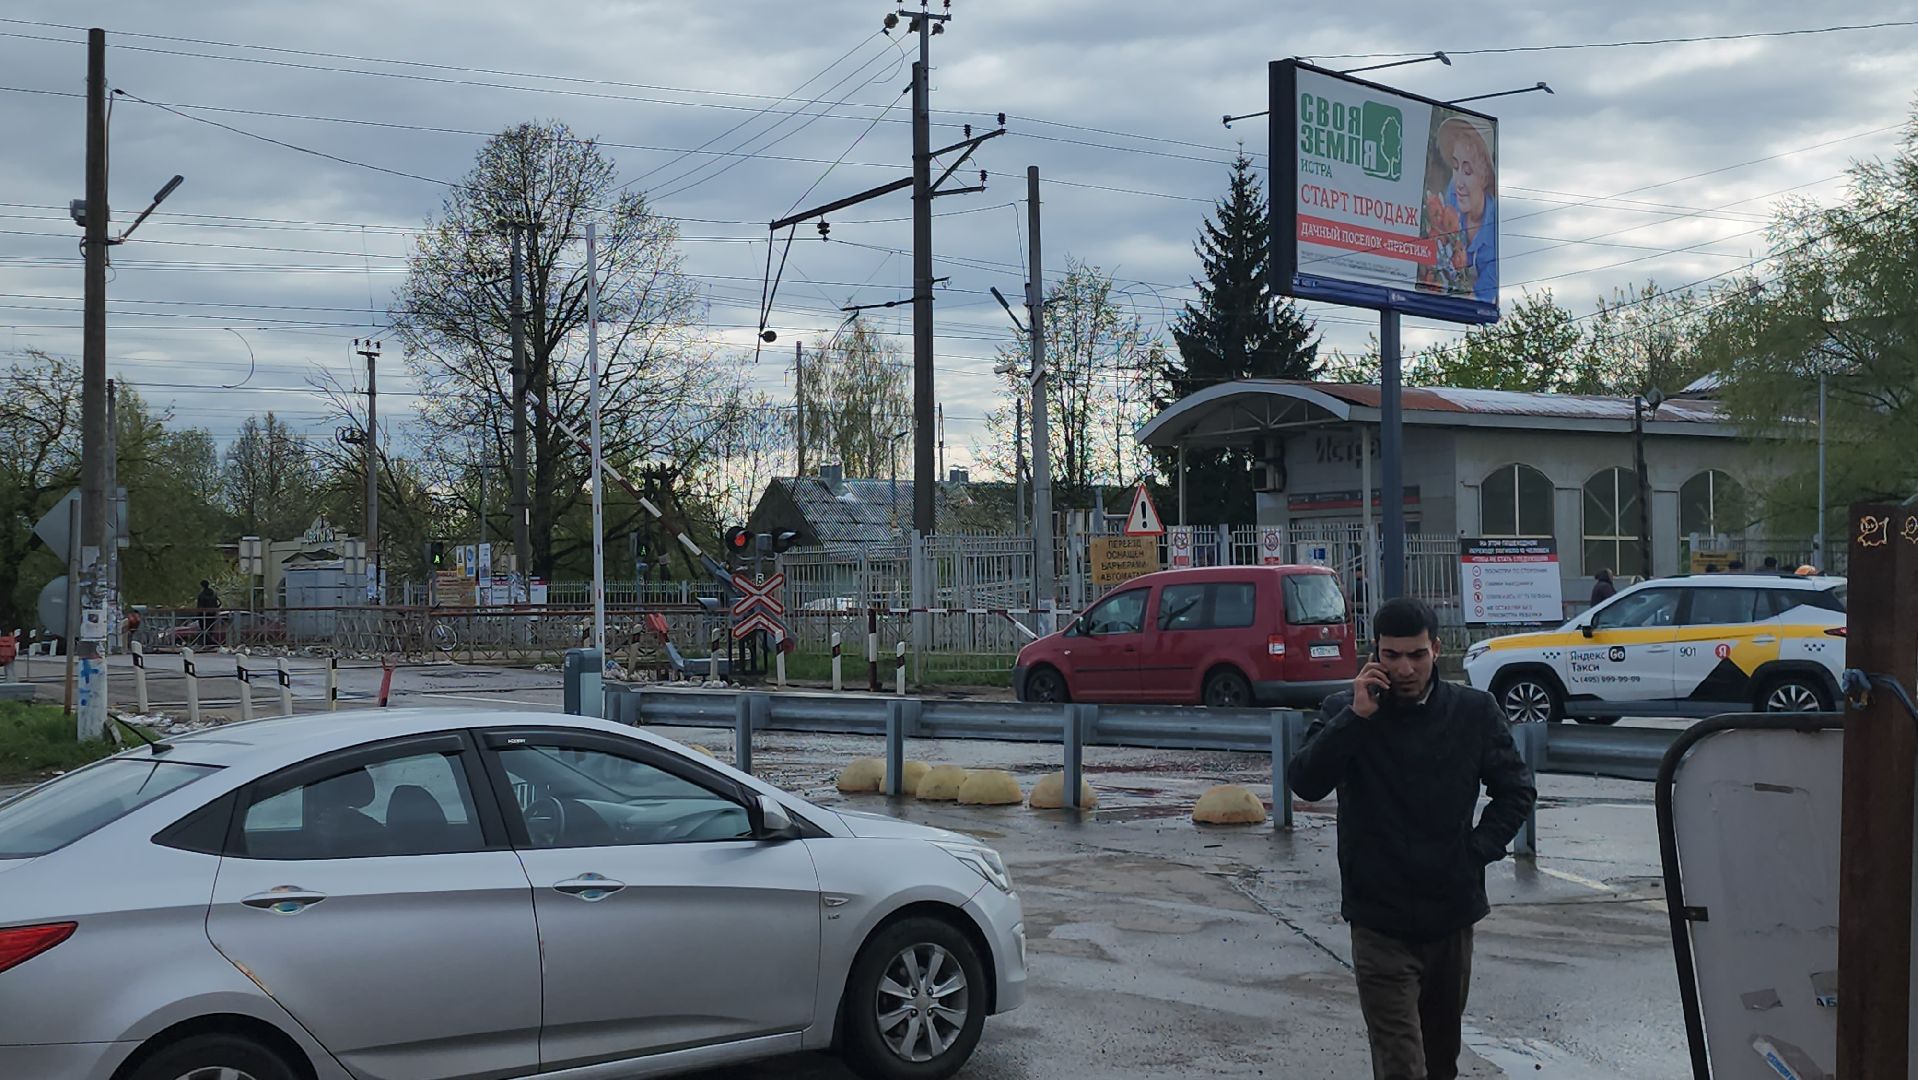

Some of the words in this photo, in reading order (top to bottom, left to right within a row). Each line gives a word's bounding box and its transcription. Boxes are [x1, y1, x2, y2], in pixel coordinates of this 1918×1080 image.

[1300, 92, 1361, 137] СВОЯ
[1300, 123, 1377, 170] ЗЕМЛЯ
[1300, 158, 1333, 179] ИСТРА
[1301, 183, 1350, 212] СТАРТ
[1353, 194, 1419, 227] ПРОДАЖ
[1301, 222, 1341, 242] ДАЧНЫЙ
[1342, 230, 1382, 249] ПОСЕЛОК
[1570, 650, 1605, 661] Яндекс
[1610, 648, 1625, 660] Go
[1679, 646, 1696, 657] 901
[1571, 662, 1600, 672] Такси
